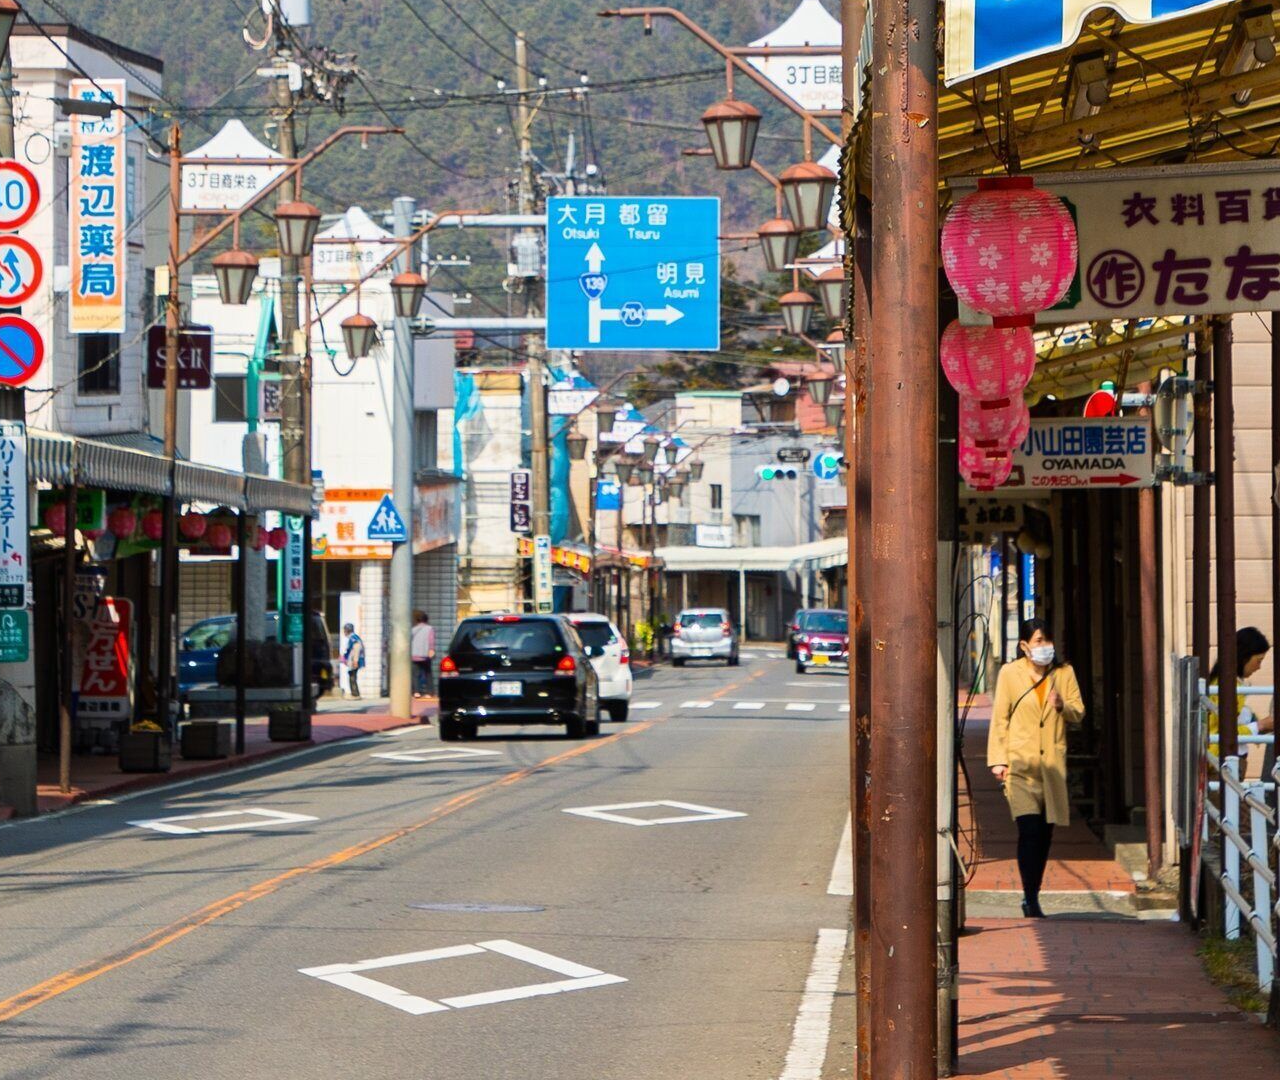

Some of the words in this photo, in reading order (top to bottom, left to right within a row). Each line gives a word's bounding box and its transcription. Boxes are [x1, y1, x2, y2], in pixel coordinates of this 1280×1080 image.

[188, 172, 257, 189] 3丁目商栄会
[79, 144, 116, 296] 渡辺薬局
[557, 204, 606, 225] 大月
[619, 204, 668, 226] 都留
[562, 228, 600, 240] Otsuki
[627, 228, 661, 241] Tsuru
[656, 262, 706, 285] 明見
[663, 287, 700, 299] Asumi
[1041, 457, 1127, 471] OYAMADA
